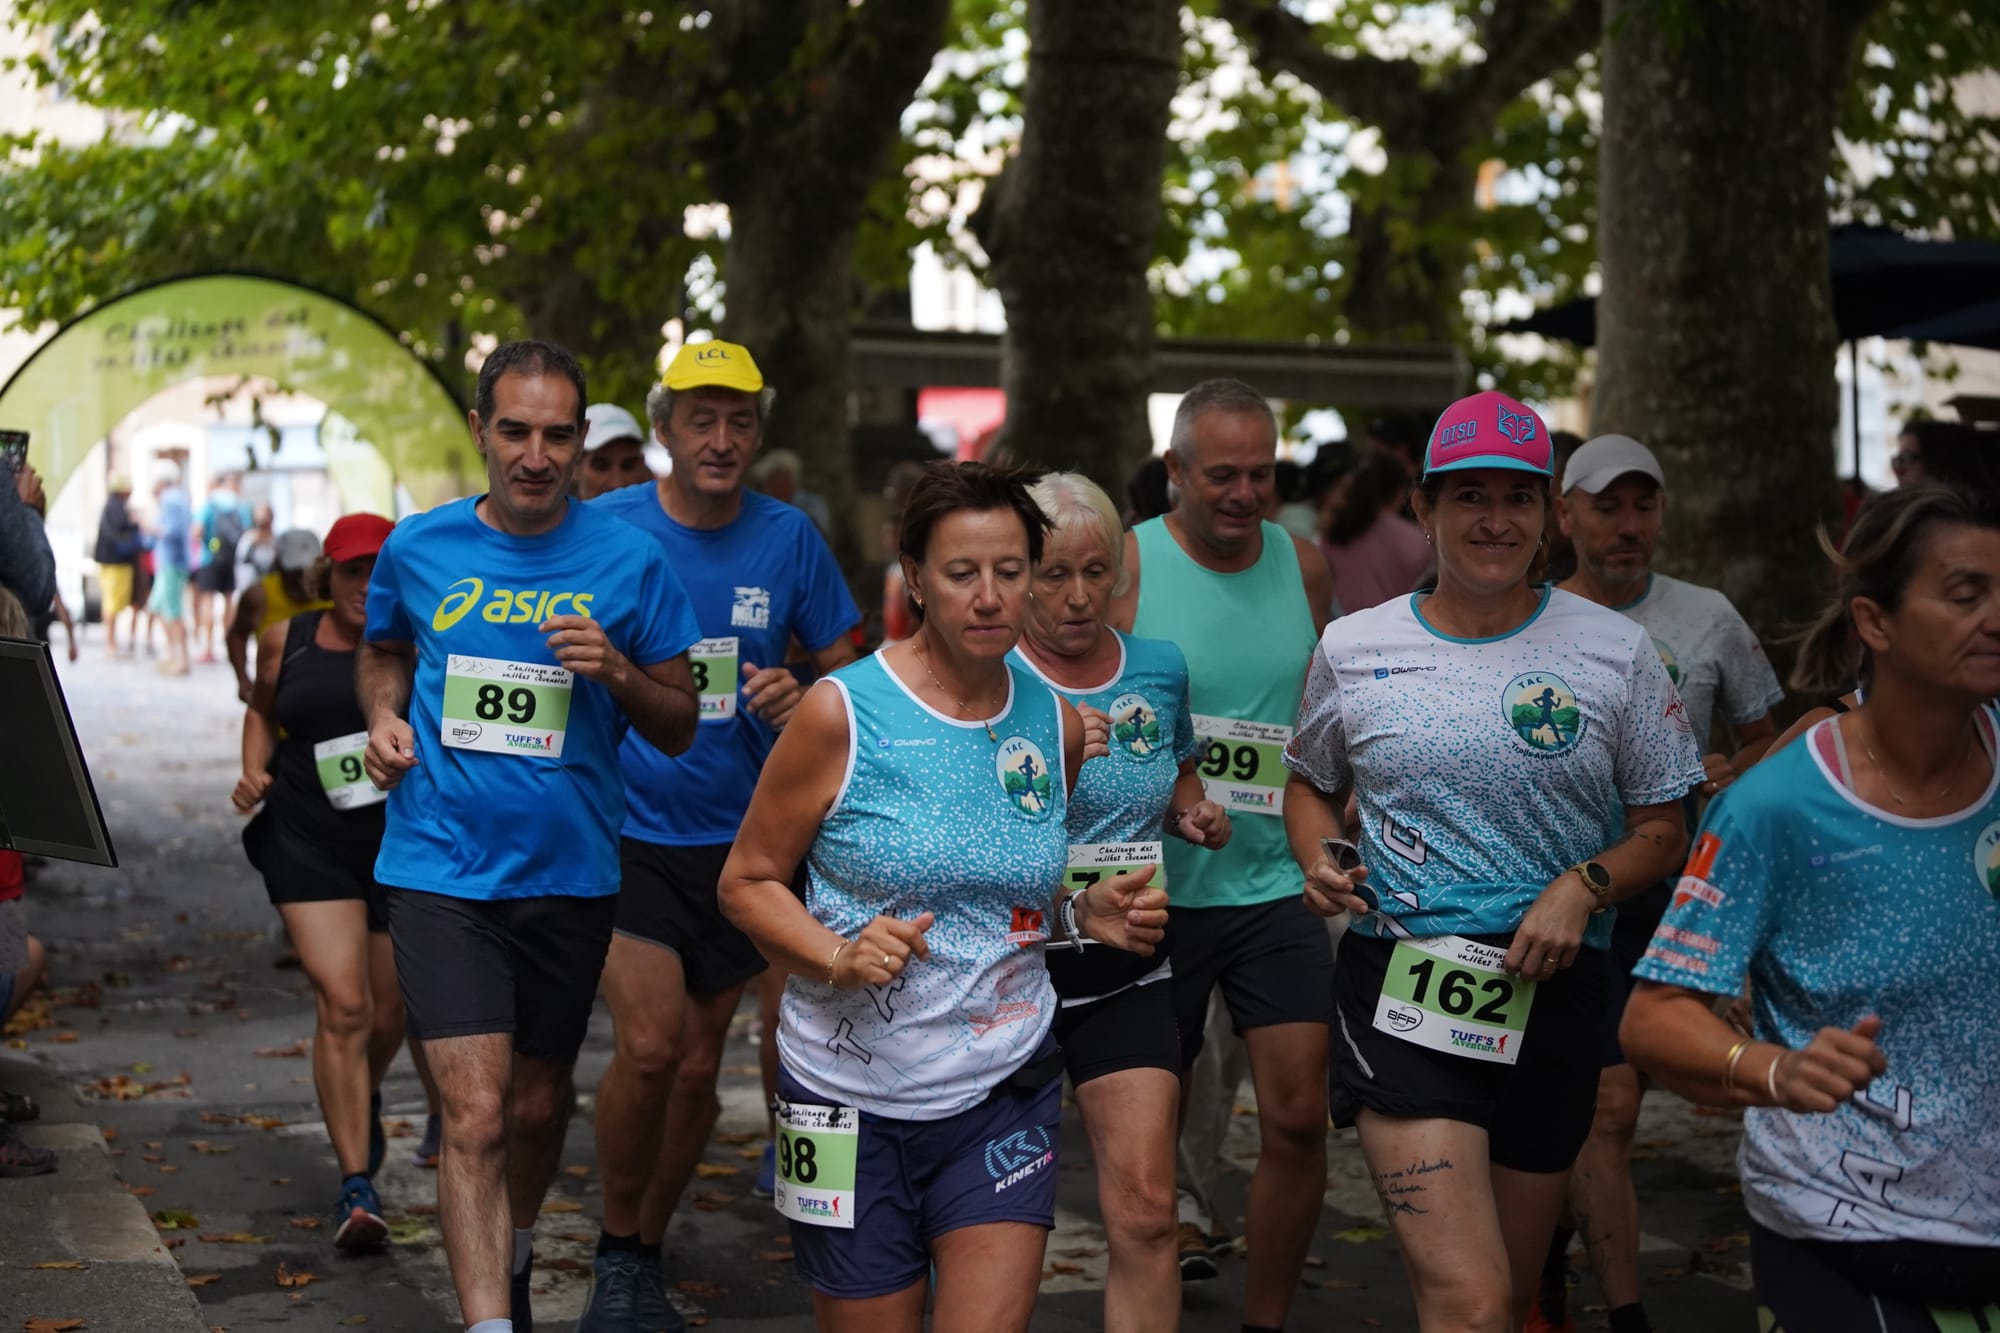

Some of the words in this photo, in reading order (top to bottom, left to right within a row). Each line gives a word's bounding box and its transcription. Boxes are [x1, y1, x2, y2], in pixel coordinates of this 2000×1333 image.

[698, 348, 732, 360] LCL
[1441, 420, 1477, 445] OTSO
[482, 589, 594, 624] asics
[507, 664, 548, 677] Challenge
[1517, 677, 1543, 688] TAC
[475, 684, 536, 724] 89
[1116, 698, 1133, 710] TAC
[505, 734, 542, 744] TUFF'S
[1005, 742, 1023, 754] TAC
[1202, 742, 1259, 780] 99
[1099, 846, 1136, 855] Challenge
[1457, 953, 1491, 967] vallées
[1408, 958, 1513, 1025] 162
[1387, 1009, 1417, 1025] BFP
[1450, 1028, 1495, 1046] TUFF'S
[1452, 1038, 1497, 1053] Aventure
[781, 1131, 818, 1184] 98
[797, 1196, 829, 1210] TUFF'S
